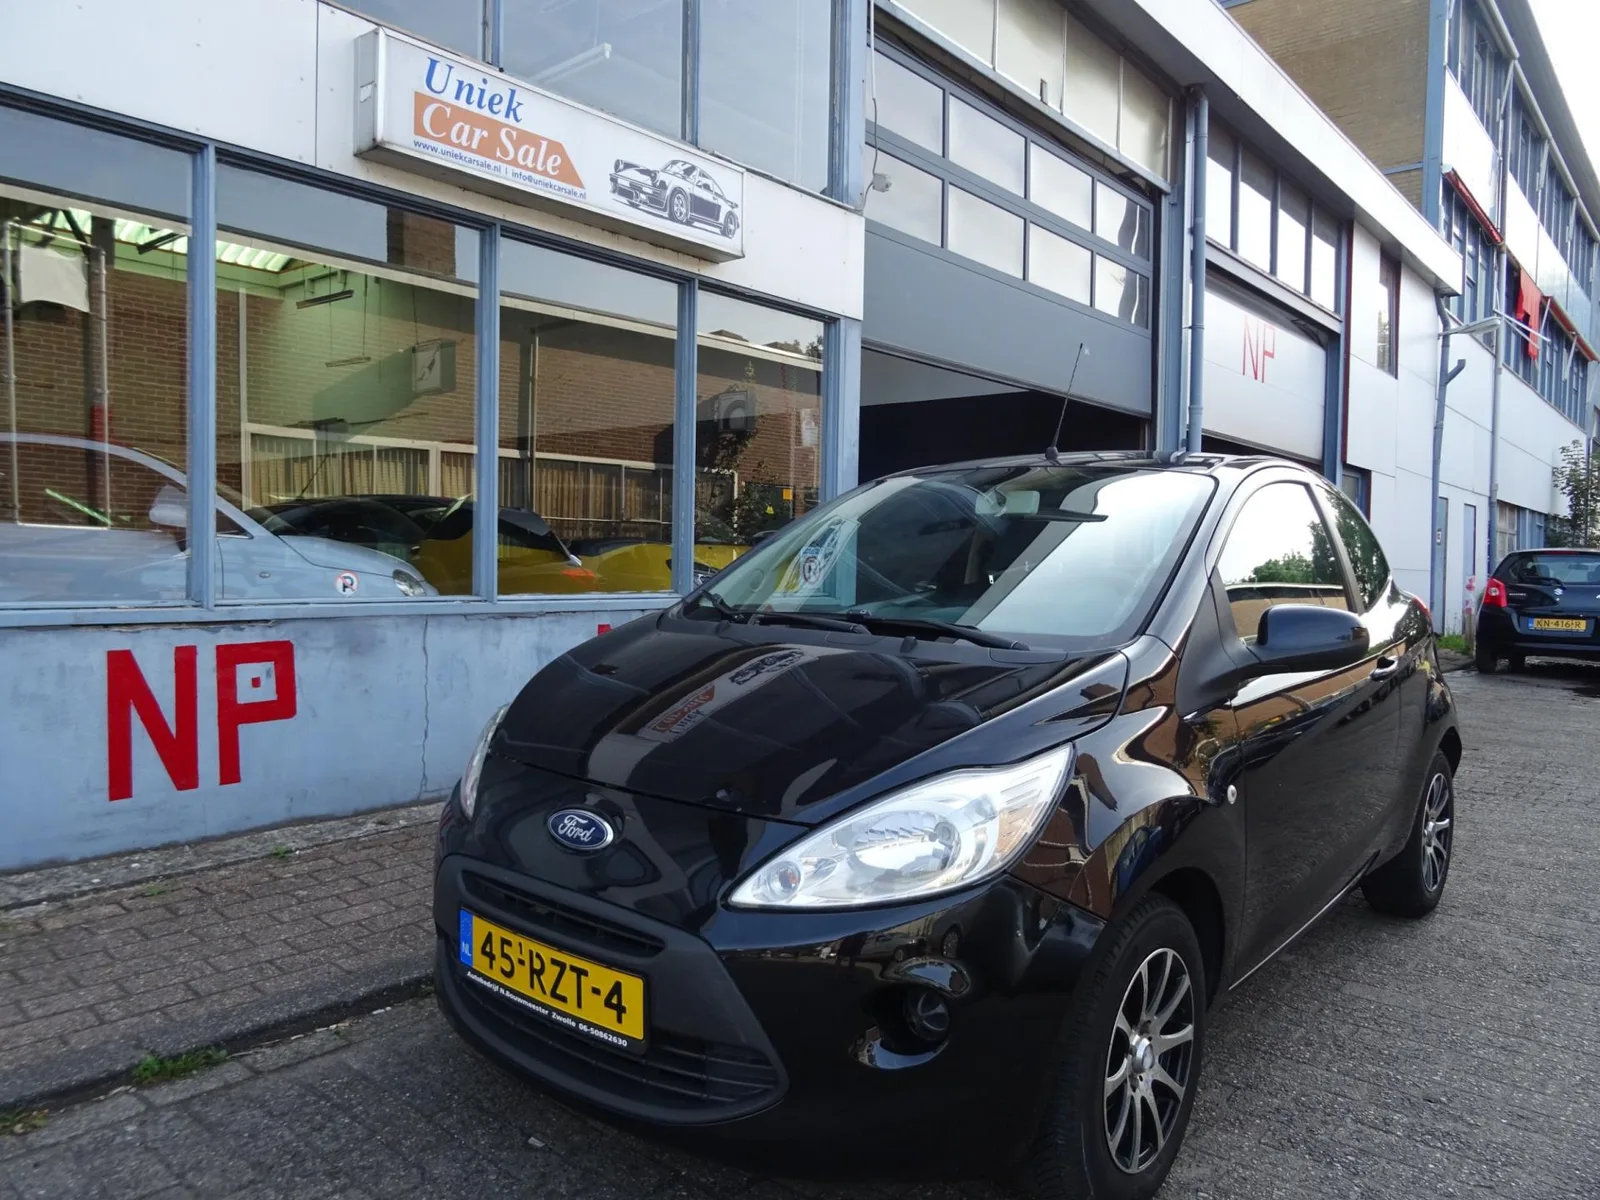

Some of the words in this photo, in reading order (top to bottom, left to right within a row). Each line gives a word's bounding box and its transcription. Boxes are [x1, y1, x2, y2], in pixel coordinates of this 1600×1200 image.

[424, 57, 524, 123] Uniek
[413, 140, 501, 172] www.uniekcarsale.nl
[512, 170, 586, 200] info@uniekcarsale.nl
[422, 102, 489, 148] Car
[496, 126, 562, 176] Sale
[1242, 315, 1275, 383] NP
[107, 640, 297, 802] NP
[558, 814, 595, 842] Ford
[461, 941, 472, 957] NL
[551, 1011, 577, 1028] Zwolle
